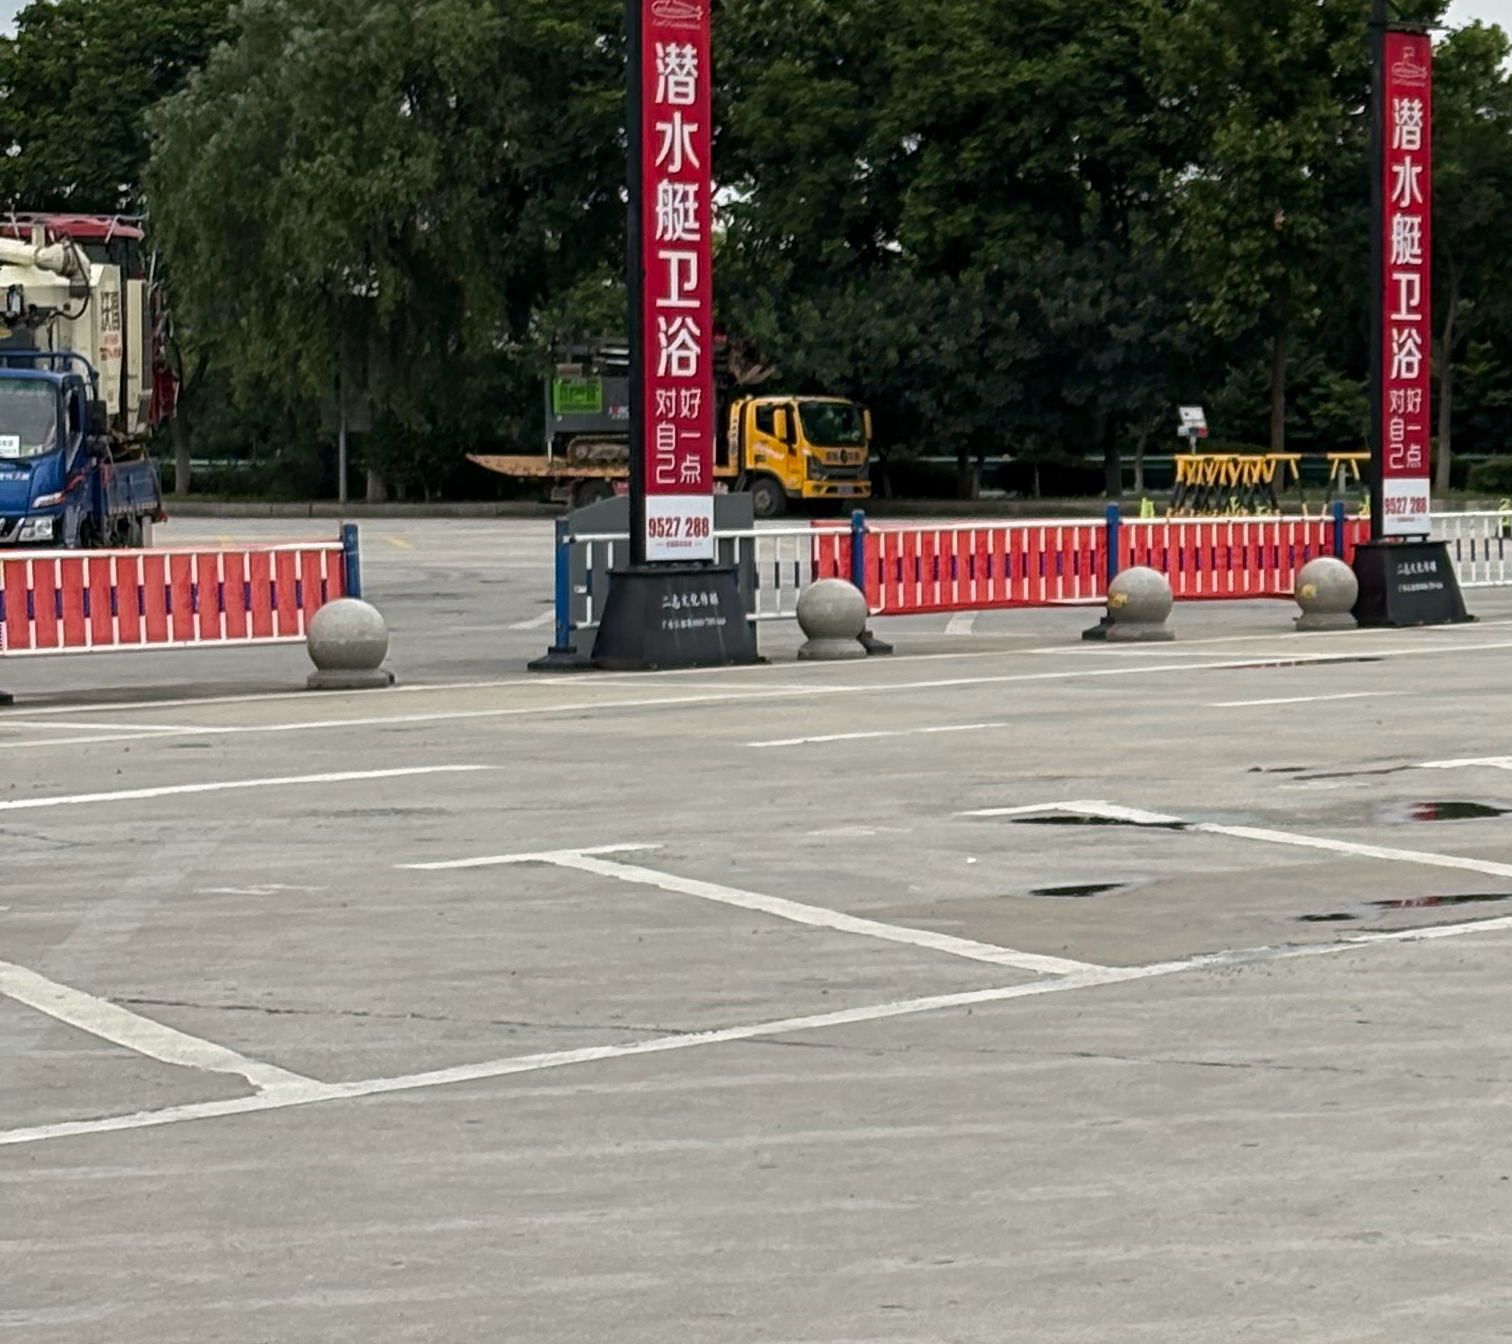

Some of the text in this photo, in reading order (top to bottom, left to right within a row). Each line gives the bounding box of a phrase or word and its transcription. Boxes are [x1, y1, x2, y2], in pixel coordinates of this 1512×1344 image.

[654, 41, 702, 377] 潜水艇卫浴
[1389, 97, 1424, 380] 潜水艇卫浴
[655, 388, 677, 484] 对自己
[680, 387, 702, 484] 好一点
[648, 516, 710, 539] 9527 288
